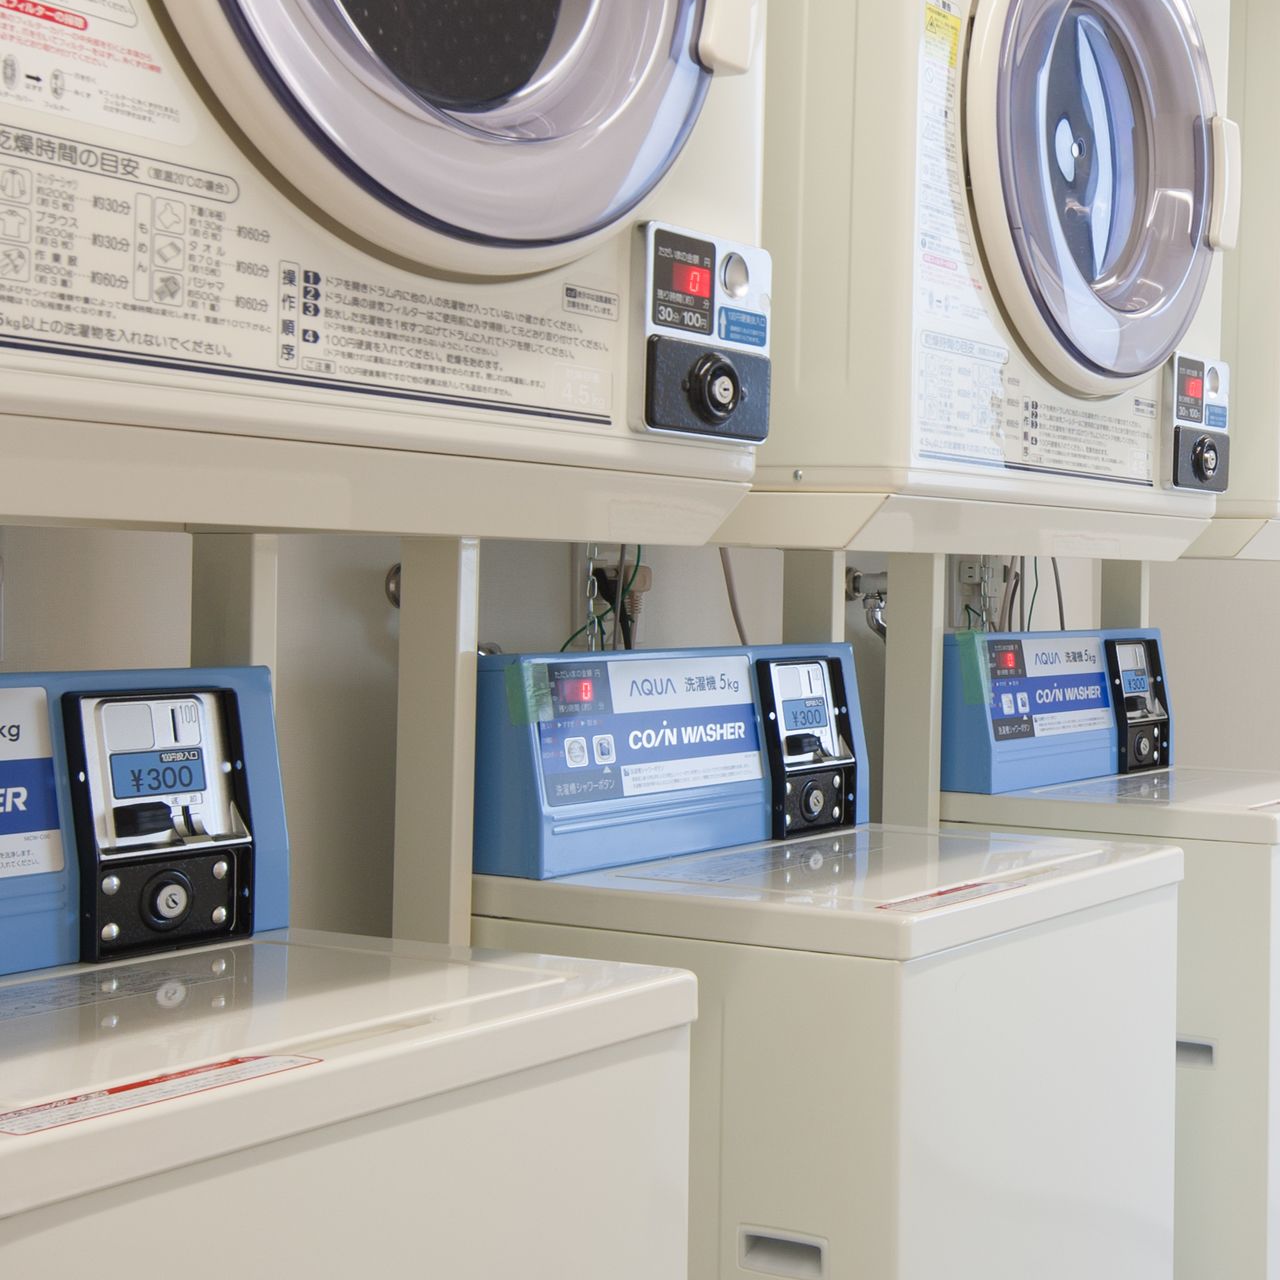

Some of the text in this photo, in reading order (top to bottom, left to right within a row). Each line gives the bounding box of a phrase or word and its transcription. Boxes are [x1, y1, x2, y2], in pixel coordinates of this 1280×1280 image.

[689, 271, 700, 293] 0
[1034, 651, 1061, 666] AQUA
[1084, 649, 1097, 665] 5kg
[582, 682, 591, 700] 0
[630, 672, 740, 697] AQUA 洗濯機 5kg
[1065, 685, 1101, 701] WASHER
[792, 709, 822, 727] ¥300
[682, 722, 746, 745] WASHER
[130, 765, 193, 793] ¥300
